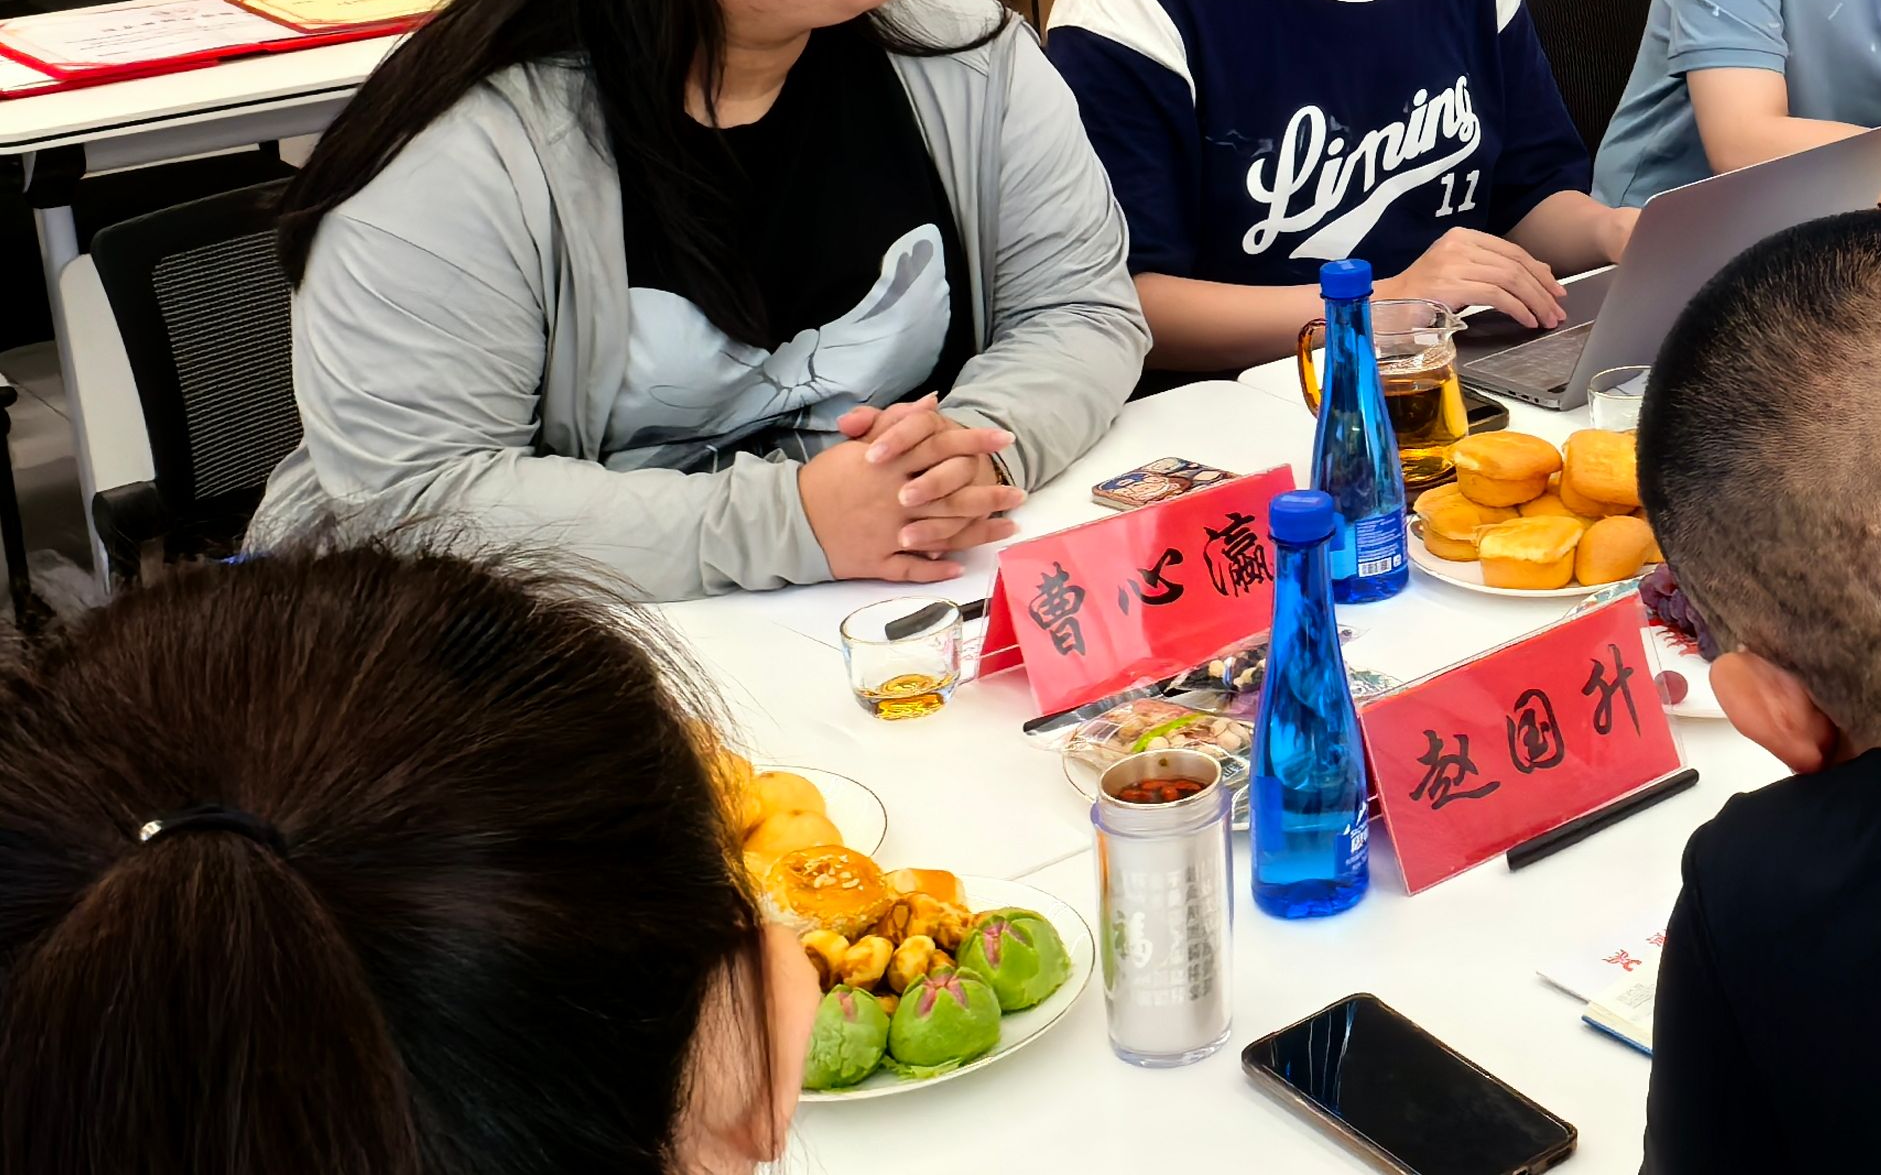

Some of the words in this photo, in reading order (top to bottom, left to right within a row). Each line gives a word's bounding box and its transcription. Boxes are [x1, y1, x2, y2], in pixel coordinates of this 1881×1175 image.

[1242, 75, 1481, 260] Lining
[1435, 169, 1480, 218] 11
[1409, 643, 1641, 810] 赵国升
